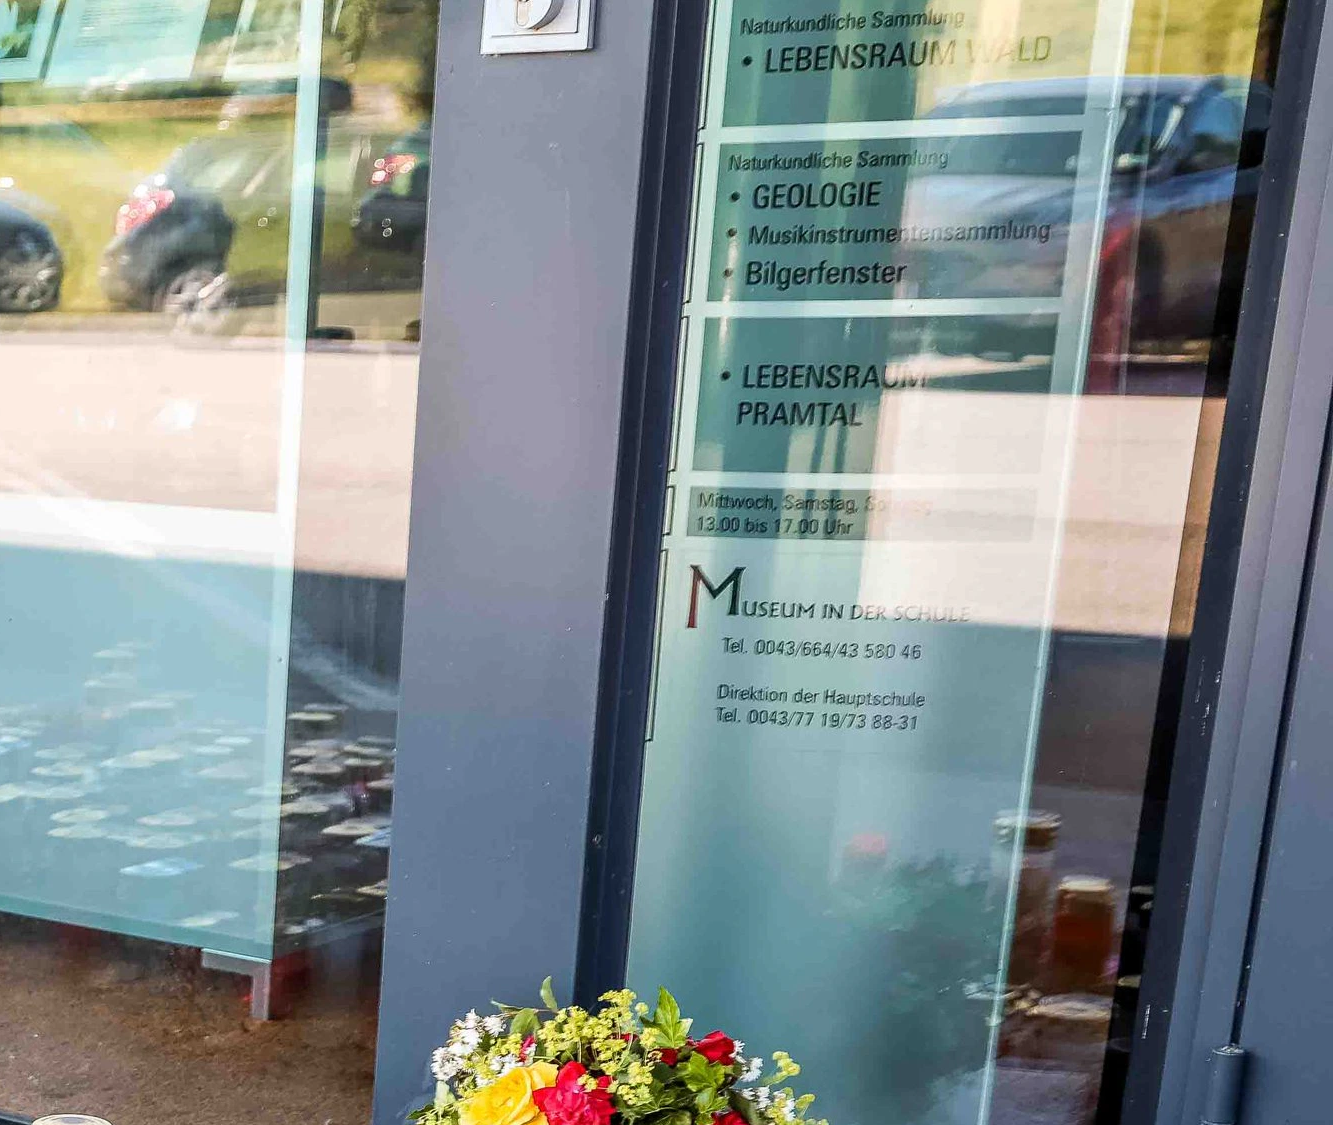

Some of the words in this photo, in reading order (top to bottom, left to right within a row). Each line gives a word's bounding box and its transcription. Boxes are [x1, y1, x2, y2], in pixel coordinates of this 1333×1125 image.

[740, 12, 867, 35] Naturkundliche
[871, 10, 965, 30] Sammlung
[765, 41, 956, 73] LEBENSRAUM
[728, 152, 853, 172] Naturkundliche
[856, 150, 949, 169] Sammlung
[752, 181, 882, 209] GEOLOGIE
[748, 221, 1052, 246] Musikinstrumentensammlung
[745, 261, 907, 291] Bilgerfenster
[742, 363, 928, 390] LEBENSRAUM
[736, 401, 863, 427] PRAMTAL
[699, 492, 776, 512] Mittwoch,
[784, 494, 859, 514] Samstag,
[697, 516, 740, 533] 13.00
[745, 517, 768, 533] bis
[774, 518, 818, 535] 17.00
[825, 519, 854, 535] Uhr
[822, 602, 844, 620] IN
[850, 603, 887, 622] DER
[893, 604, 971, 624] SCHULE
[723, 637, 748, 655] Tel.
[753, 637, 860, 659] 0043/664/43
[864, 641, 896, 659] 580
[900, 643, 923, 660] 46
[717, 684, 789, 704] Direktion
[794, 687, 820, 705] der
[823, 688, 926, 711] Hauptschule
[716, 707, 741, 725] Tel.
[746, 708, 815, 728] 0043/77
[821, 711, 867, 730] 19/73
[872, 713, 919, 731] 88-31
